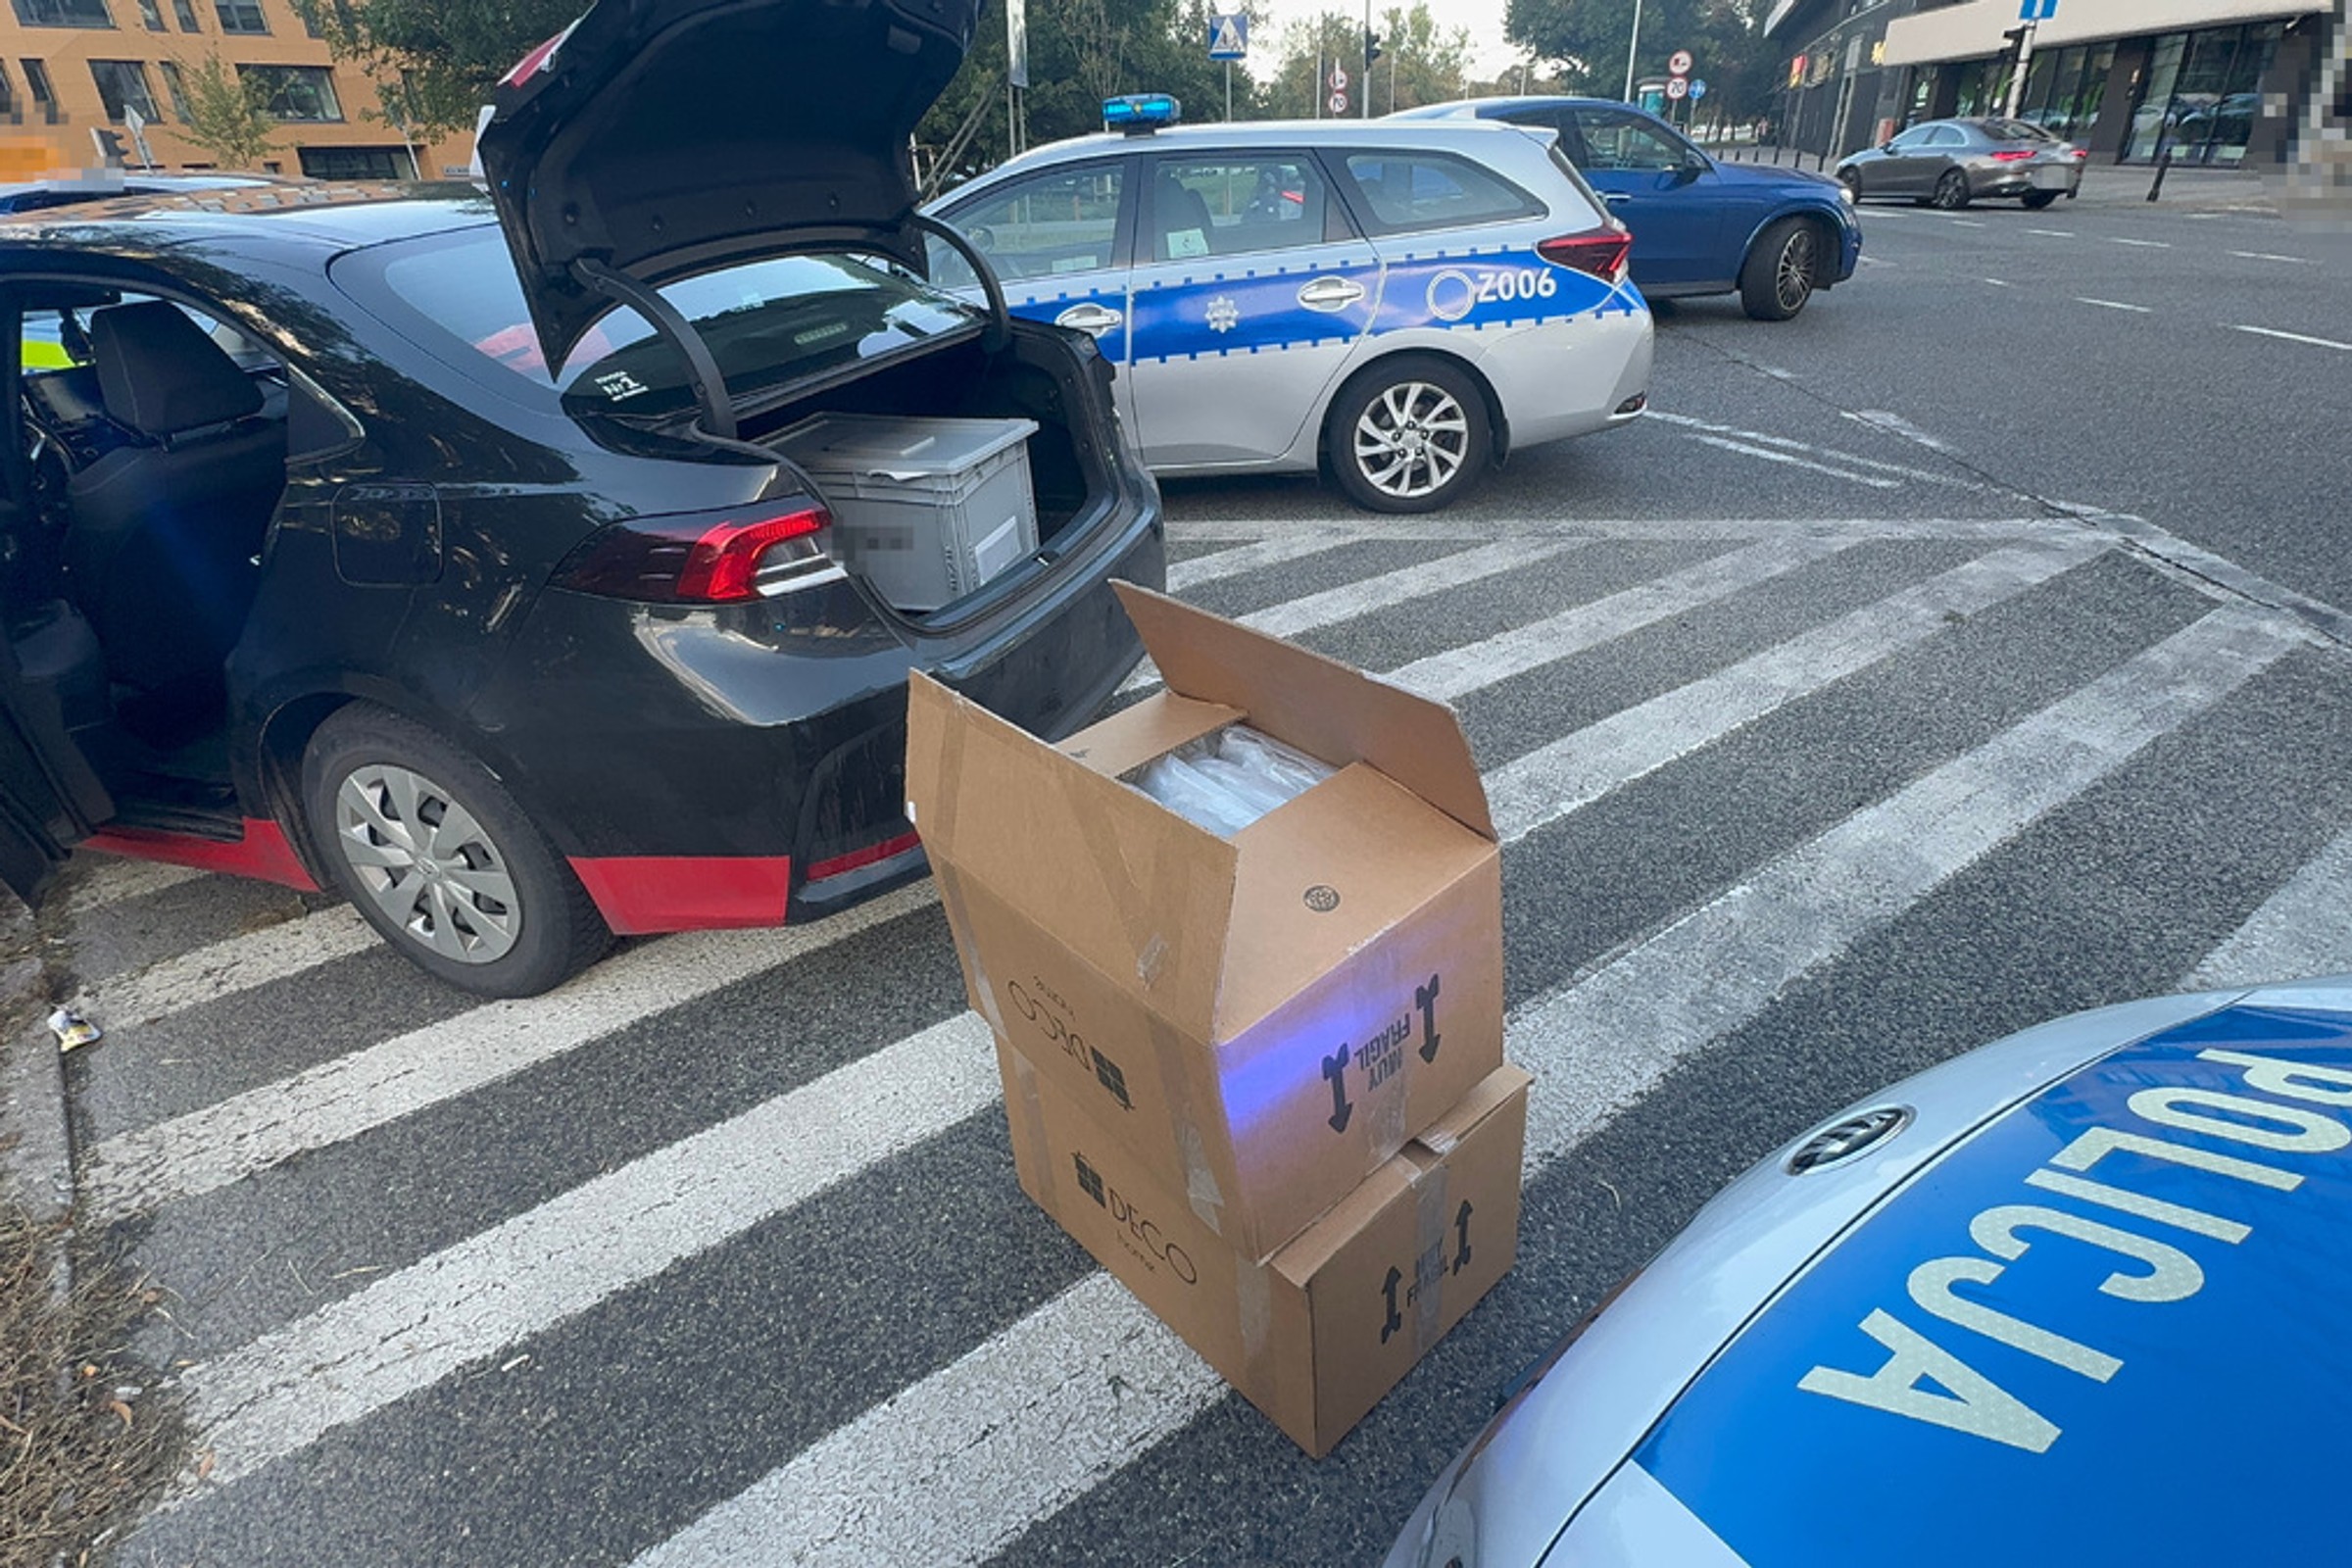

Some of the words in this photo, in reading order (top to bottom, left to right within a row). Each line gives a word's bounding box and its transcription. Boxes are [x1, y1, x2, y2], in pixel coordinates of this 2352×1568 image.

[1477, 268, 1557, 303] Z006
[1008, 980, 1092, 1072] DECO
[1354, 1012, 1410, 1071] FRAGIL
[1368, 1047, 1402, 1093] MUY
[1107, 1187, 1198, 1284] DECO
[1797, 1048, 2352, 1454] POLICJA
